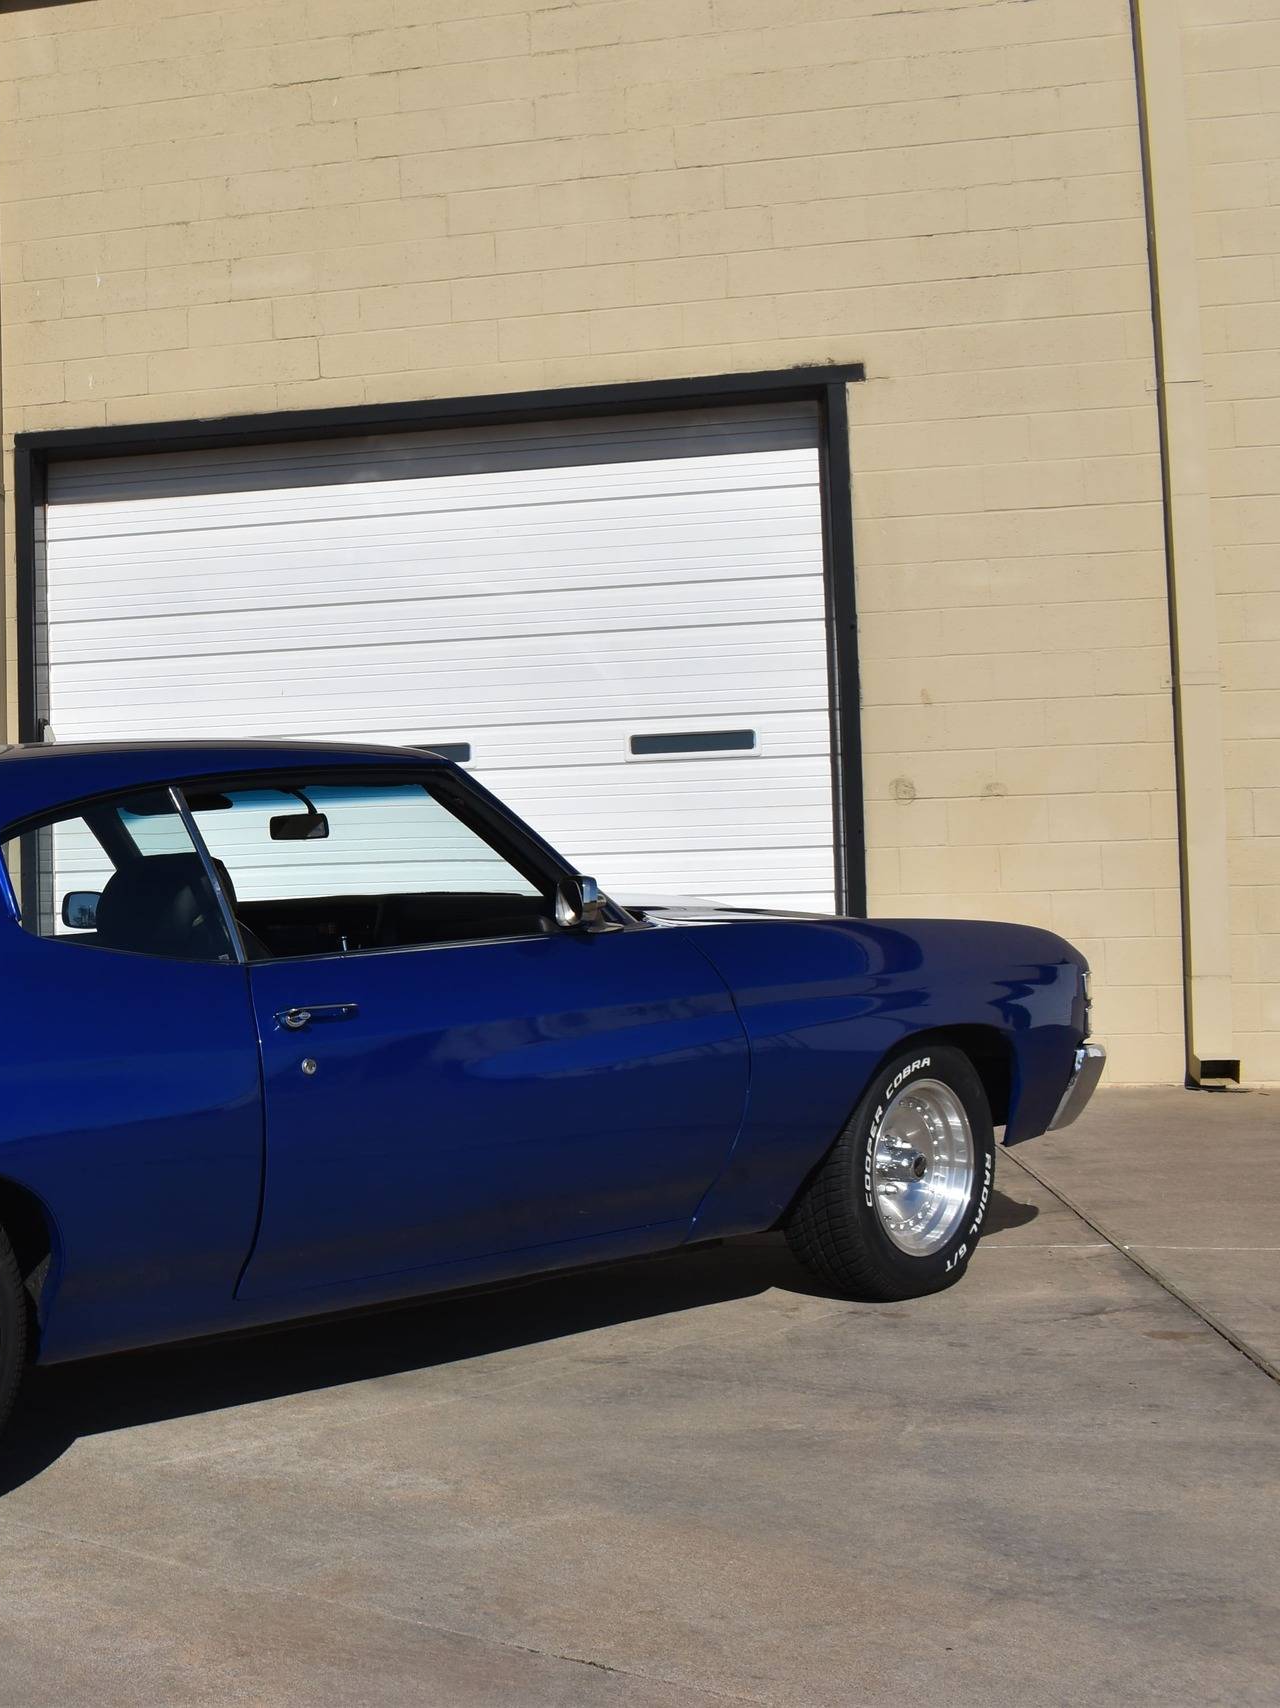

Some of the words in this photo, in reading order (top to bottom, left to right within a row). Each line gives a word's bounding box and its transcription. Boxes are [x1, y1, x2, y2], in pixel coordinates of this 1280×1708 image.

[864, 1105, 883, 1208] COOPER
[885, 1056, 932, 1100] COBRA
[969, 1152, 992, 1236] RADIAL
